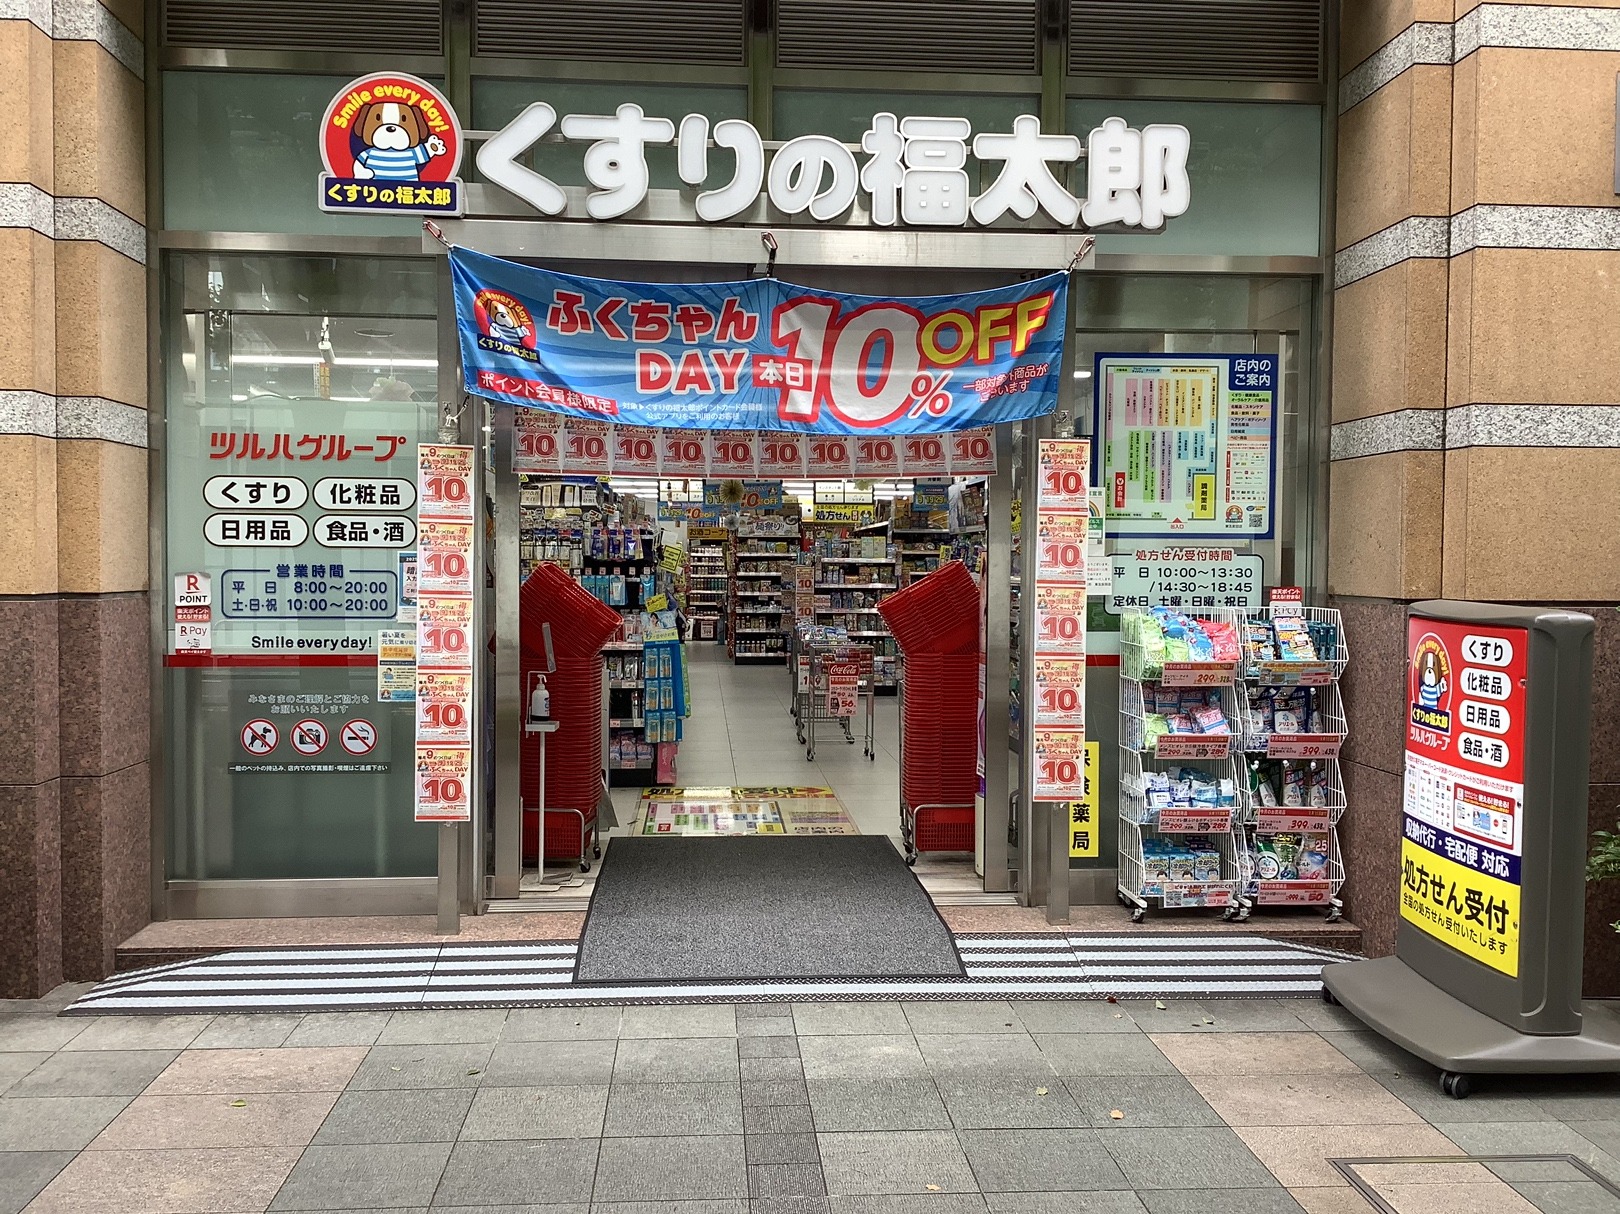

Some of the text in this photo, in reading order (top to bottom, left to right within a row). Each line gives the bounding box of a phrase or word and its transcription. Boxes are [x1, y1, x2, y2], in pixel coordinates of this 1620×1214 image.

[333, 84, 450, 132] Smile every day!
[476, 101, 1191, 229] くすりの福太郎
[327, 185, 451, 206] くすりの福太郎
[516, 304, 532, 325] day!
[547, 289, 758, 343] ふくちゃん
[921, 295, 1053, 366] OFF
[636, 349, 749, 395] DAY
[758, 359, 805, 387] 本日
[1234, 359, 1271, 371] 店内の
[1234, 373, 1270, 386] ご案内
[481, 372, 613, 413] ポイント会員様限定
[209, 432, 407, 462] ツルハグループ
[519, 434, 555, 456] 10
[568, 437, 604, 458] 10
[618, 439, 654, 460] 10
[667, 441, 702, 462] 10
[715, 442, 750, 463] 10
[763, 443, 798, 463] 10
[811, 442, 847, 463] 10
[858, 441, 894, 462] 10
[905, 440, 941, 461] 10
[954, 439, 990, 459] 10
[221, 482, 291, 505] くすり
[426, 477, 466, 501] 10
[1046, 472, 1082, 494] 10
[330, 483, 401, 505] 化粧品
[816, 510, 850, 520] 処方せん
[221, 520, 291, 541] 日用品
[326, 521, 405, 542] 食品・酒
[425, 552, 465, 577] 10
[1044, 545, 1081, 567] 10
[1136, 550, 1233, 562] 処方せん受付時間
[276, 564, 344, 578] 営業時間
[187, 575, 200, 590] R
[1113, 596, 1149, 607] 定休日
[190, 626, 207, 636] Pay
[425, 627, 465, 651] 10
[1042, 617, 1079, 640] 10
[251, 635, 372, 651] Smile every day!
[1469, 640, 1503, 662] くすり
[1467, 672, 1503, 696] 化粧品
[271, 705, 349, 714] お願いいたします
[1041, 689, 1077, 711] 10
[423, 702, 463, 727] 10
[1412, 708, 1449, 729] くすりの福太郎
[1466, 705, 1500, 729] 日用品
[1303, 747, 1319, 755] 399
[1410, 731, 1450, 750] ツルハグループ
[1463, 737, 1503, 762] 食品・酒
[1040, 761, 1077, 783] 10
[422, 778, 463, 802] 10
[1291, 820, 1308, 828] 399
[1316, 840, 1327, 851] 25
[1481, 850, 1509, 878] 対応
[1404, 855, 1509, 934] 処方せん受付
[1403, 892, 1508, 955] 全国の処方せん受付いたします
